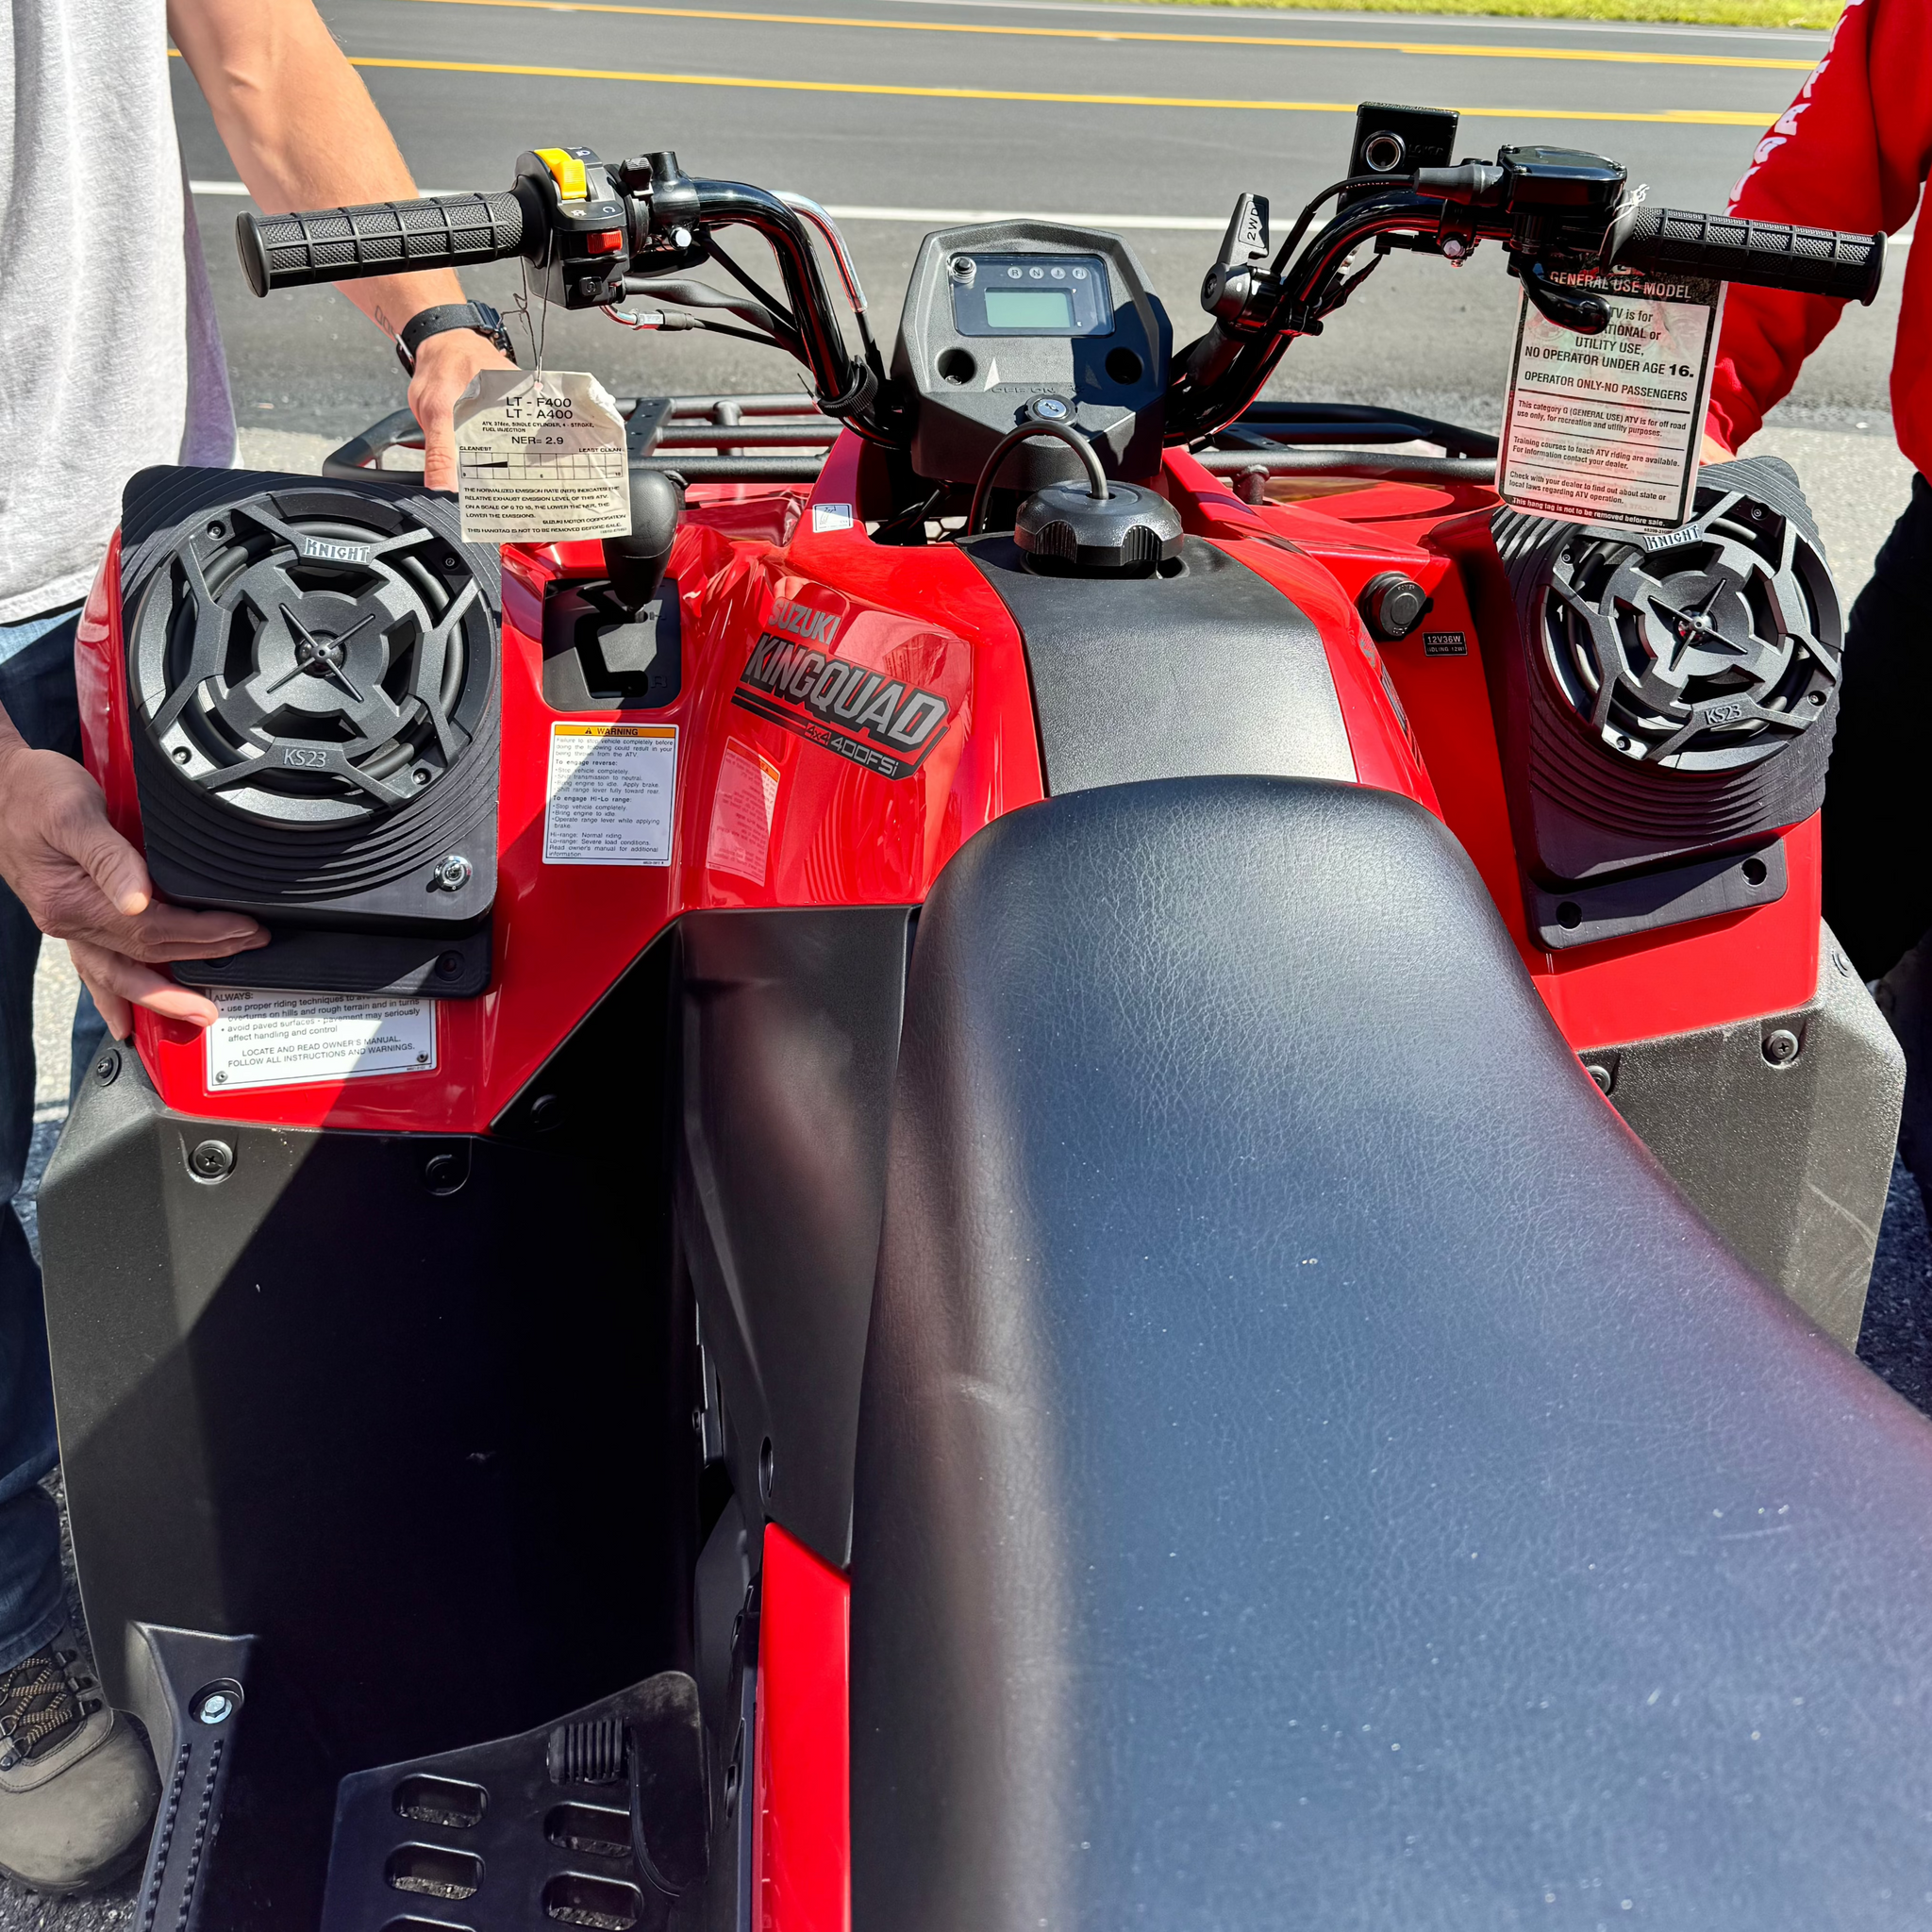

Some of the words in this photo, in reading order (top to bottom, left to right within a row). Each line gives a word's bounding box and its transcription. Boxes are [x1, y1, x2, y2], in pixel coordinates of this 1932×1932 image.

[1247, 208, 1259, 241] 2WD
[1549, 271, 1608, 290] GENERAL
[1613, 279, 1639, 292] USE
[1643, 282, 1691, 299] MODEL
[1610, 307, 1624, 319] TV
[1625, 308, 1636, 321] is
[1638, 310, 1653, 323] for
[1575, 337, 1617, 352] UTILITY
[1619, 342, 1644, 357] USE,
[1649, 331, 1661, 341] or
[1525, 346, 1541, 358] NO
[1543, 348, 1599, 366] OPERATOR
[1602, 357, 1640, 372] UNDER
[1642, 362, 1665, 375] AGE
[1669, 364, 1694, 377] 16.
[1524, 371, 1574, 387] OPERATOR
[1576, 378, 1619, 392] ONLY-NO
[1622, 385, 1688, 402] PASSENGERS
[506, 408, 523, 418] LT
[537, 409, 573, 419] A400
[507, 396, 523, 406] LT
[537, 397, 572, 408] F400
[1519, 400, 1532, 408] This
[1533, 403, 1562, 414] category
[1570, 408, 1605, 420] (GENERAL
[1606, 413, 1624, 423] USE)
[1624, 415, 1639, 425] ATV
[1640, 417, 1646, 425] is
[1647, 418, 1658, 426] for
[1670, 422, 1686, 430] road
[1530, 411, 1545, 422] only,
[1547, 413, 1556, 422] for
[1557, 416, 1591, 427] recreation
[1592, 420, 1606, 428] and
[1607, 424, 1627, 433] utility
[1628, 425, 1662, 437] purposes.
[511, 436, 541, 444] NER=
[1514, 436, 1540, 448] Training
[1541, 441, 1566, 451] courses
[1567, 443, 1574, 452] to
[1575, 444, 1594, 455] teach
[1595, 447, 1609, 457] ATV
[1610, 451, 1631, 461] riding
[1644, 457, 1680, 467] available.
[1512, 444, 1524, 453] For
[1563, 453, 1587, 463] contact
[1588, 457, 1603, 465] your
[1605, 458, 1628, 470] dealer.
[1508, 479, 1524, 489] local
[1525, 481, 1541, 491] laws
[1542, 485, 1574, 497] regarding
[1574, 491, 1589, 499] ATV
[1590, 492, 1624, 504] operation.
[1509, 471, 1529, 480] Check
[1530, 475, 1544, 483] with
[1545, 477, 1560, 486] your
[1561, 479, 1583, 489] dealer
[1591, 483, 1605, 492] find
[1607, 486, 1618, 494] out
[1619, 488, 1639, 497] about
[1640, 491, 1657, 500] state
[1512, 497, 1527, 506] This
[1527, 499, 1543, 509] hang
[1544, 502, 1556, 510] tag
[1564, 505, 1574, 513] not
[1593, 510, 1624, 521] removed
[1624, 514, 1647, 525] before
[1648, 517, 1665, 526] sale.
[1642, 526, 1698, 550] KNIGHT
[306, 539, 369, 562] KNIGHT
[768, 599, 842, 645] SUZUKI
[744, 633, 947, 746] KINGQUAD
[1704, 704, 1741, 724] KS23
[597, 726, 639, 736] WARNING
[284, 749, 326, 768] KS23
[805, 722, 831, 745] 4x4
[830, 736, 899, 776] 400FSi
[214, 991, 254, 1002] ALWAYS:
[227, 1004, 242, 1012] use
[244, 1002, 272, 1011] proper
[274, 1000, 297, 1008] riding
[299, 995, 344, 1006] techniques
[227, 1024, 250, 1033] avoid
[252, 1022, 278, 1031] paved
[279, 1018, 315, 1027] surfaces
[323, 1013, 363, 1024] pavement
[365, 1012, 382, 1021] may
[384, 1008, 421, 1017] seriously
[228, 1013, 267, 1023] overturns
[318, 1004, 342, 1015] rough
[343, 1003, 370, 1011] terrain
[372, 1000, 387, 1009] and
[228, 1033, 252, 1042] affect
[254, 1031, 290, 1040] handling
[291, 1028, 307, 1037] and
[308, 1025, 338, 1035] control
[227, 1058, 264, 1068] FOLLOW
[283, 1050, 346, 1062] INSTRUCTIONS
[367, 1042, 415, 1055] WARNINGS.
[242, 1047, 275, 1057] LOCATE
[276, 1045, 295, 1054] AND
[297, 1042, 321, 1052] READ
[322, 1039, 361, 1050] OWNER'S
[364, 1035, 401, 1045] MANUAL.
